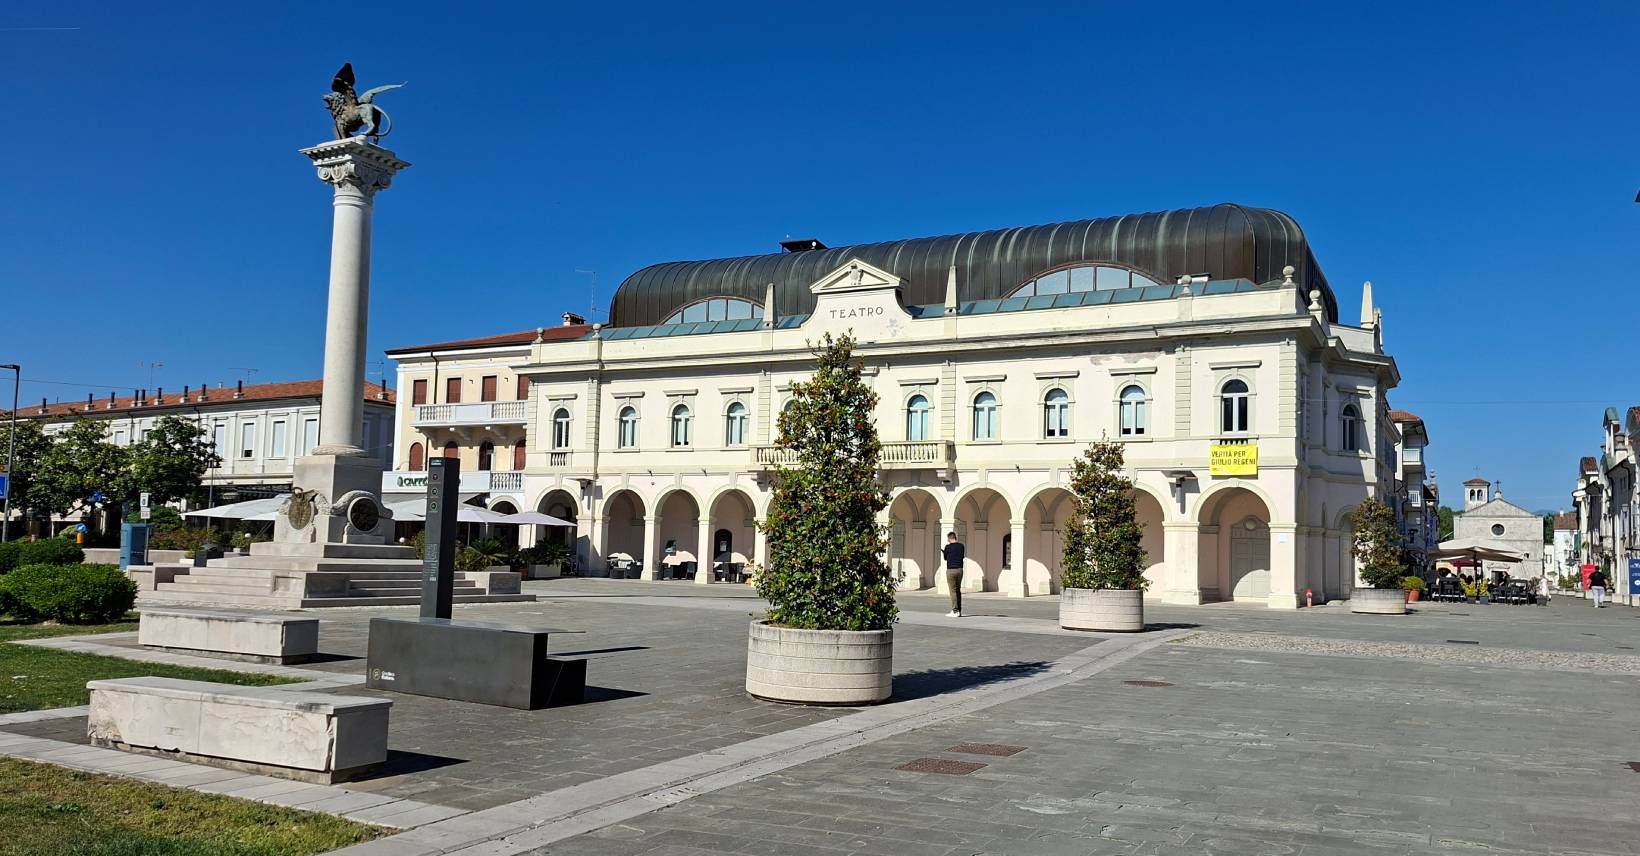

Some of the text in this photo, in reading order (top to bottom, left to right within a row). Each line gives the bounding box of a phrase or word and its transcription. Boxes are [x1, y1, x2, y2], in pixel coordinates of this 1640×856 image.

[829, 306, 884, 319] TEATRO
[1233, 450, 1246, 458] PER
[1211, 458, 1256, 466] GIULIO REGENI
